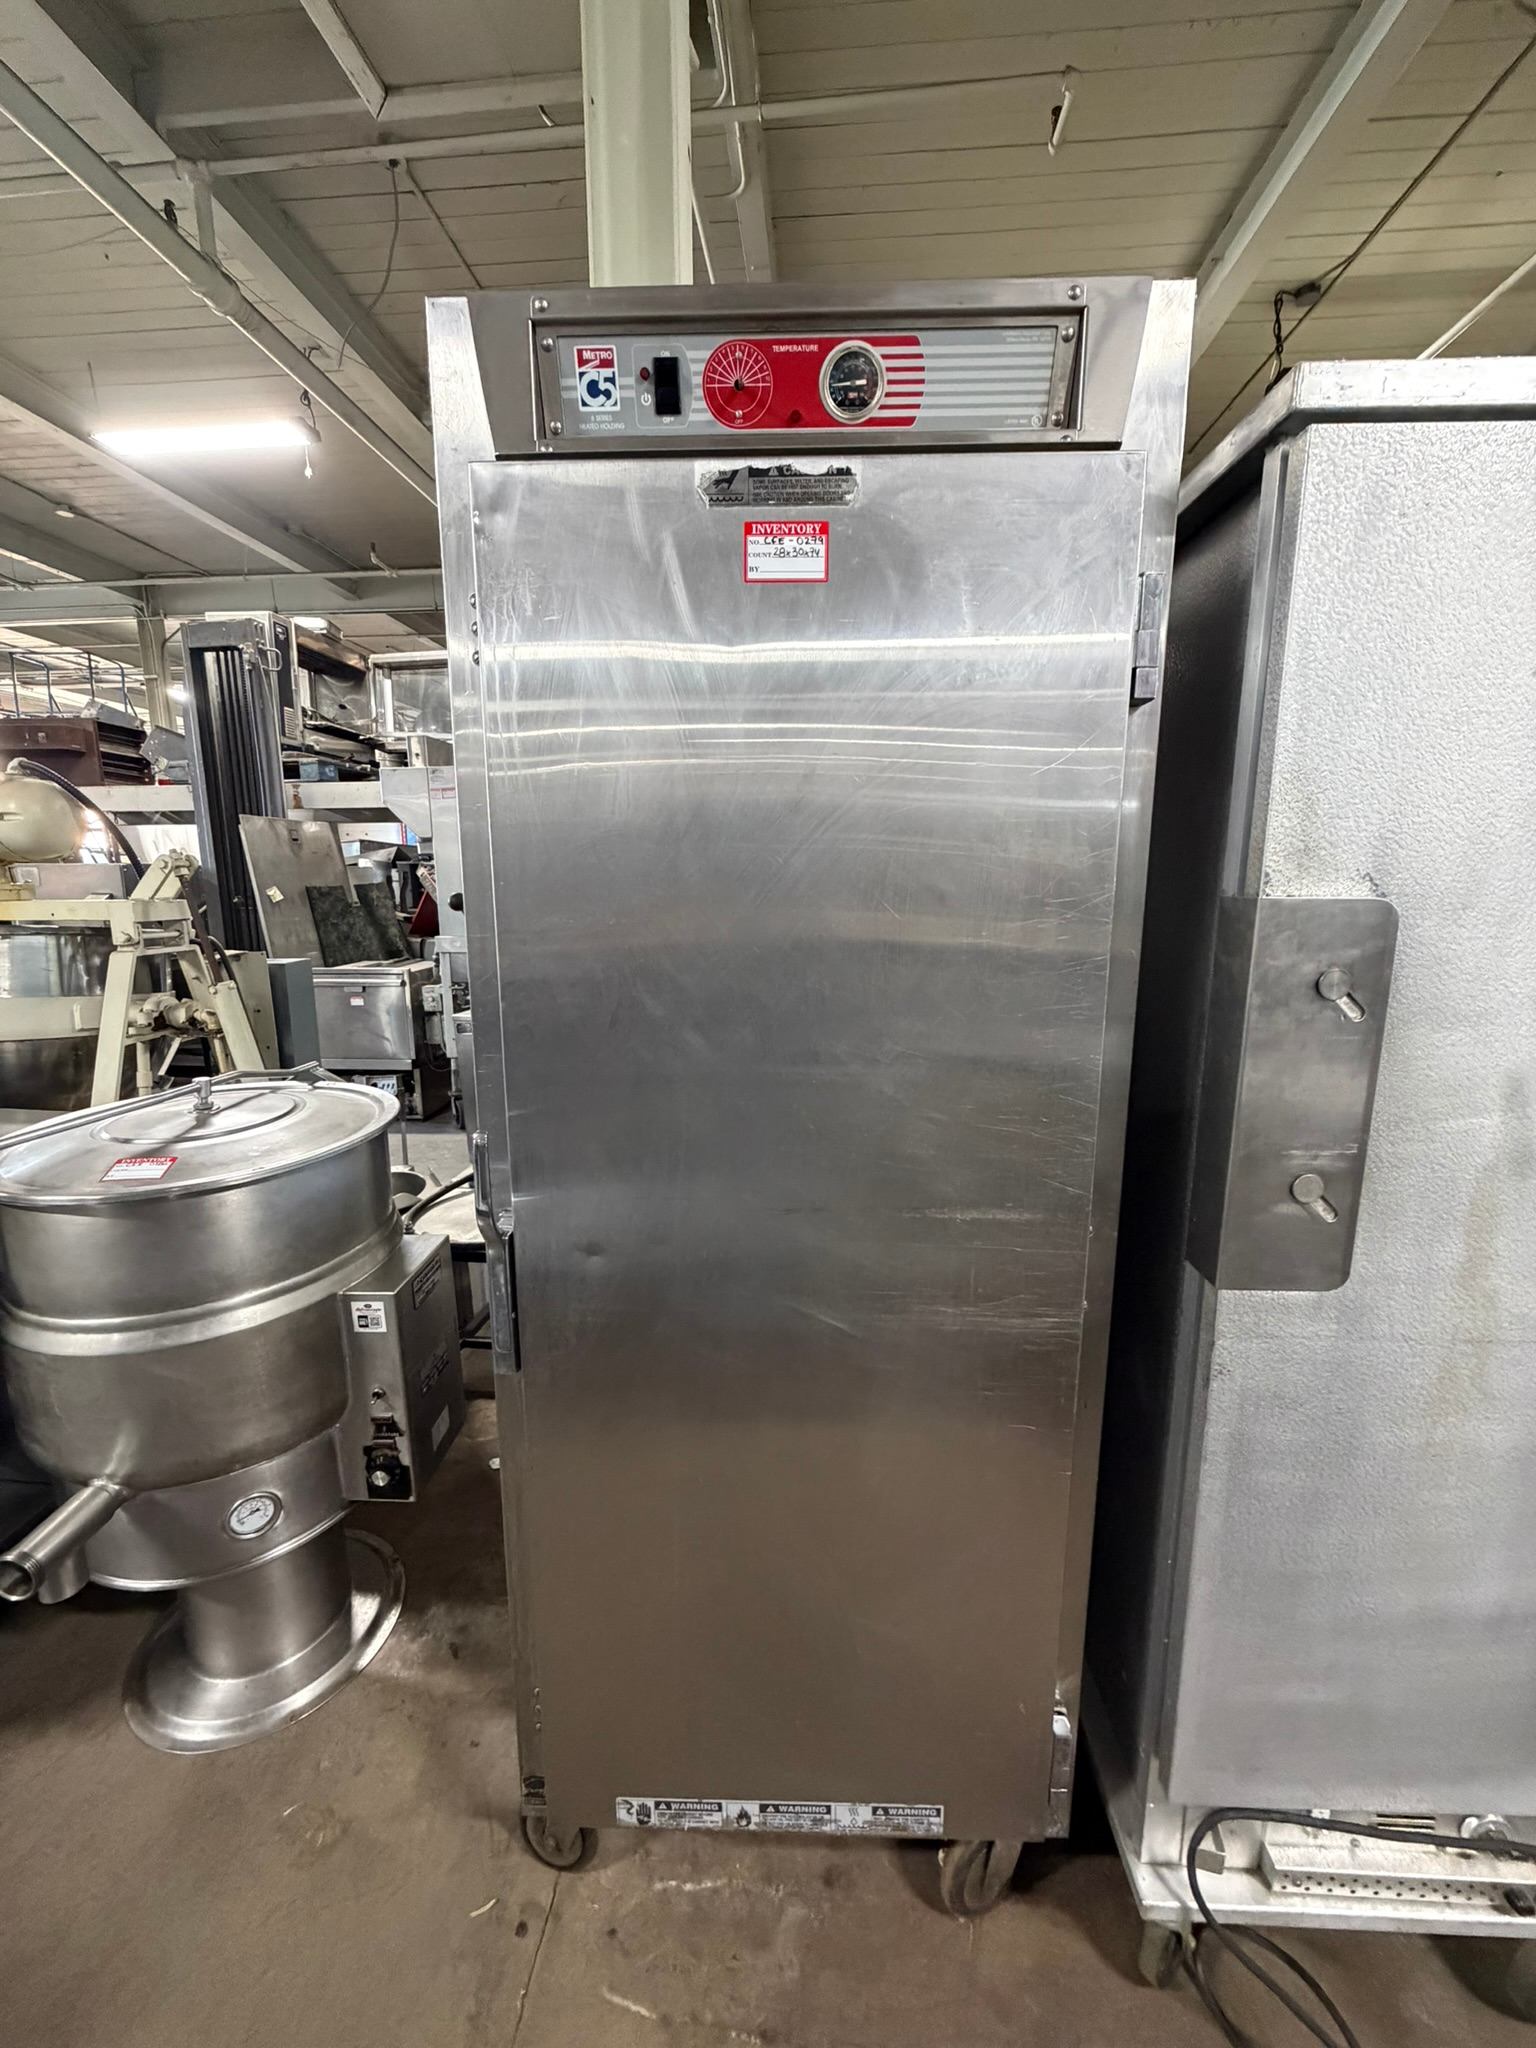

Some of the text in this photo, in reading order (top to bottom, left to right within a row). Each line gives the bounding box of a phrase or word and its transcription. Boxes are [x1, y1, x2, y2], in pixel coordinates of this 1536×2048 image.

[772, 344, 819, 353] TEMPERATURE
[582, 349, 613, 361] METRO
[579, 369, 617, 408] C5
[751, 523, 822, 534] INVENTORY
[748, 565, 760, 573] BY
[671, 1802, 719, 1811] WARNING
[779, 1804, 827, 1813] WARNING
[888, 1808, 937, 1816] WARNING
